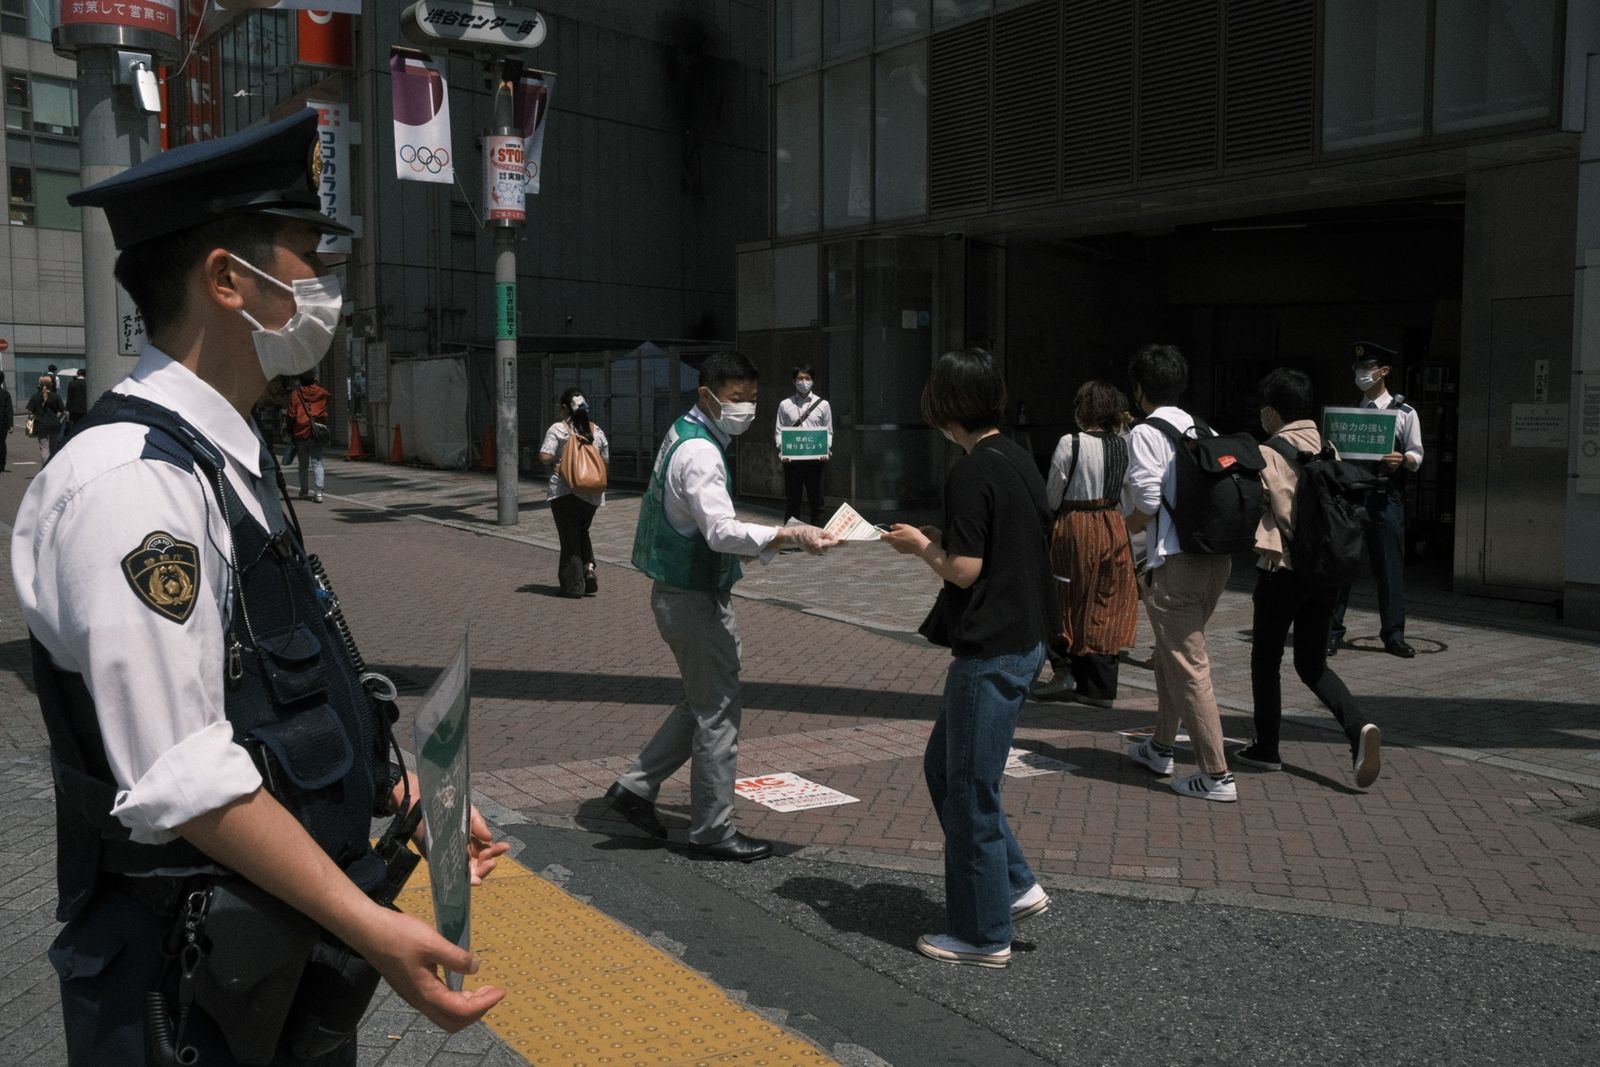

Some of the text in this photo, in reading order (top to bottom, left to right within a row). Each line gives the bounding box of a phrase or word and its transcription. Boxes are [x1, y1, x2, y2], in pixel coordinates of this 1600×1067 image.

[423, 8, 538, 35] 渋谷センター街
[122, 315, 132, 350] ストリート
[151, 539, 170, 548] TOKYO
